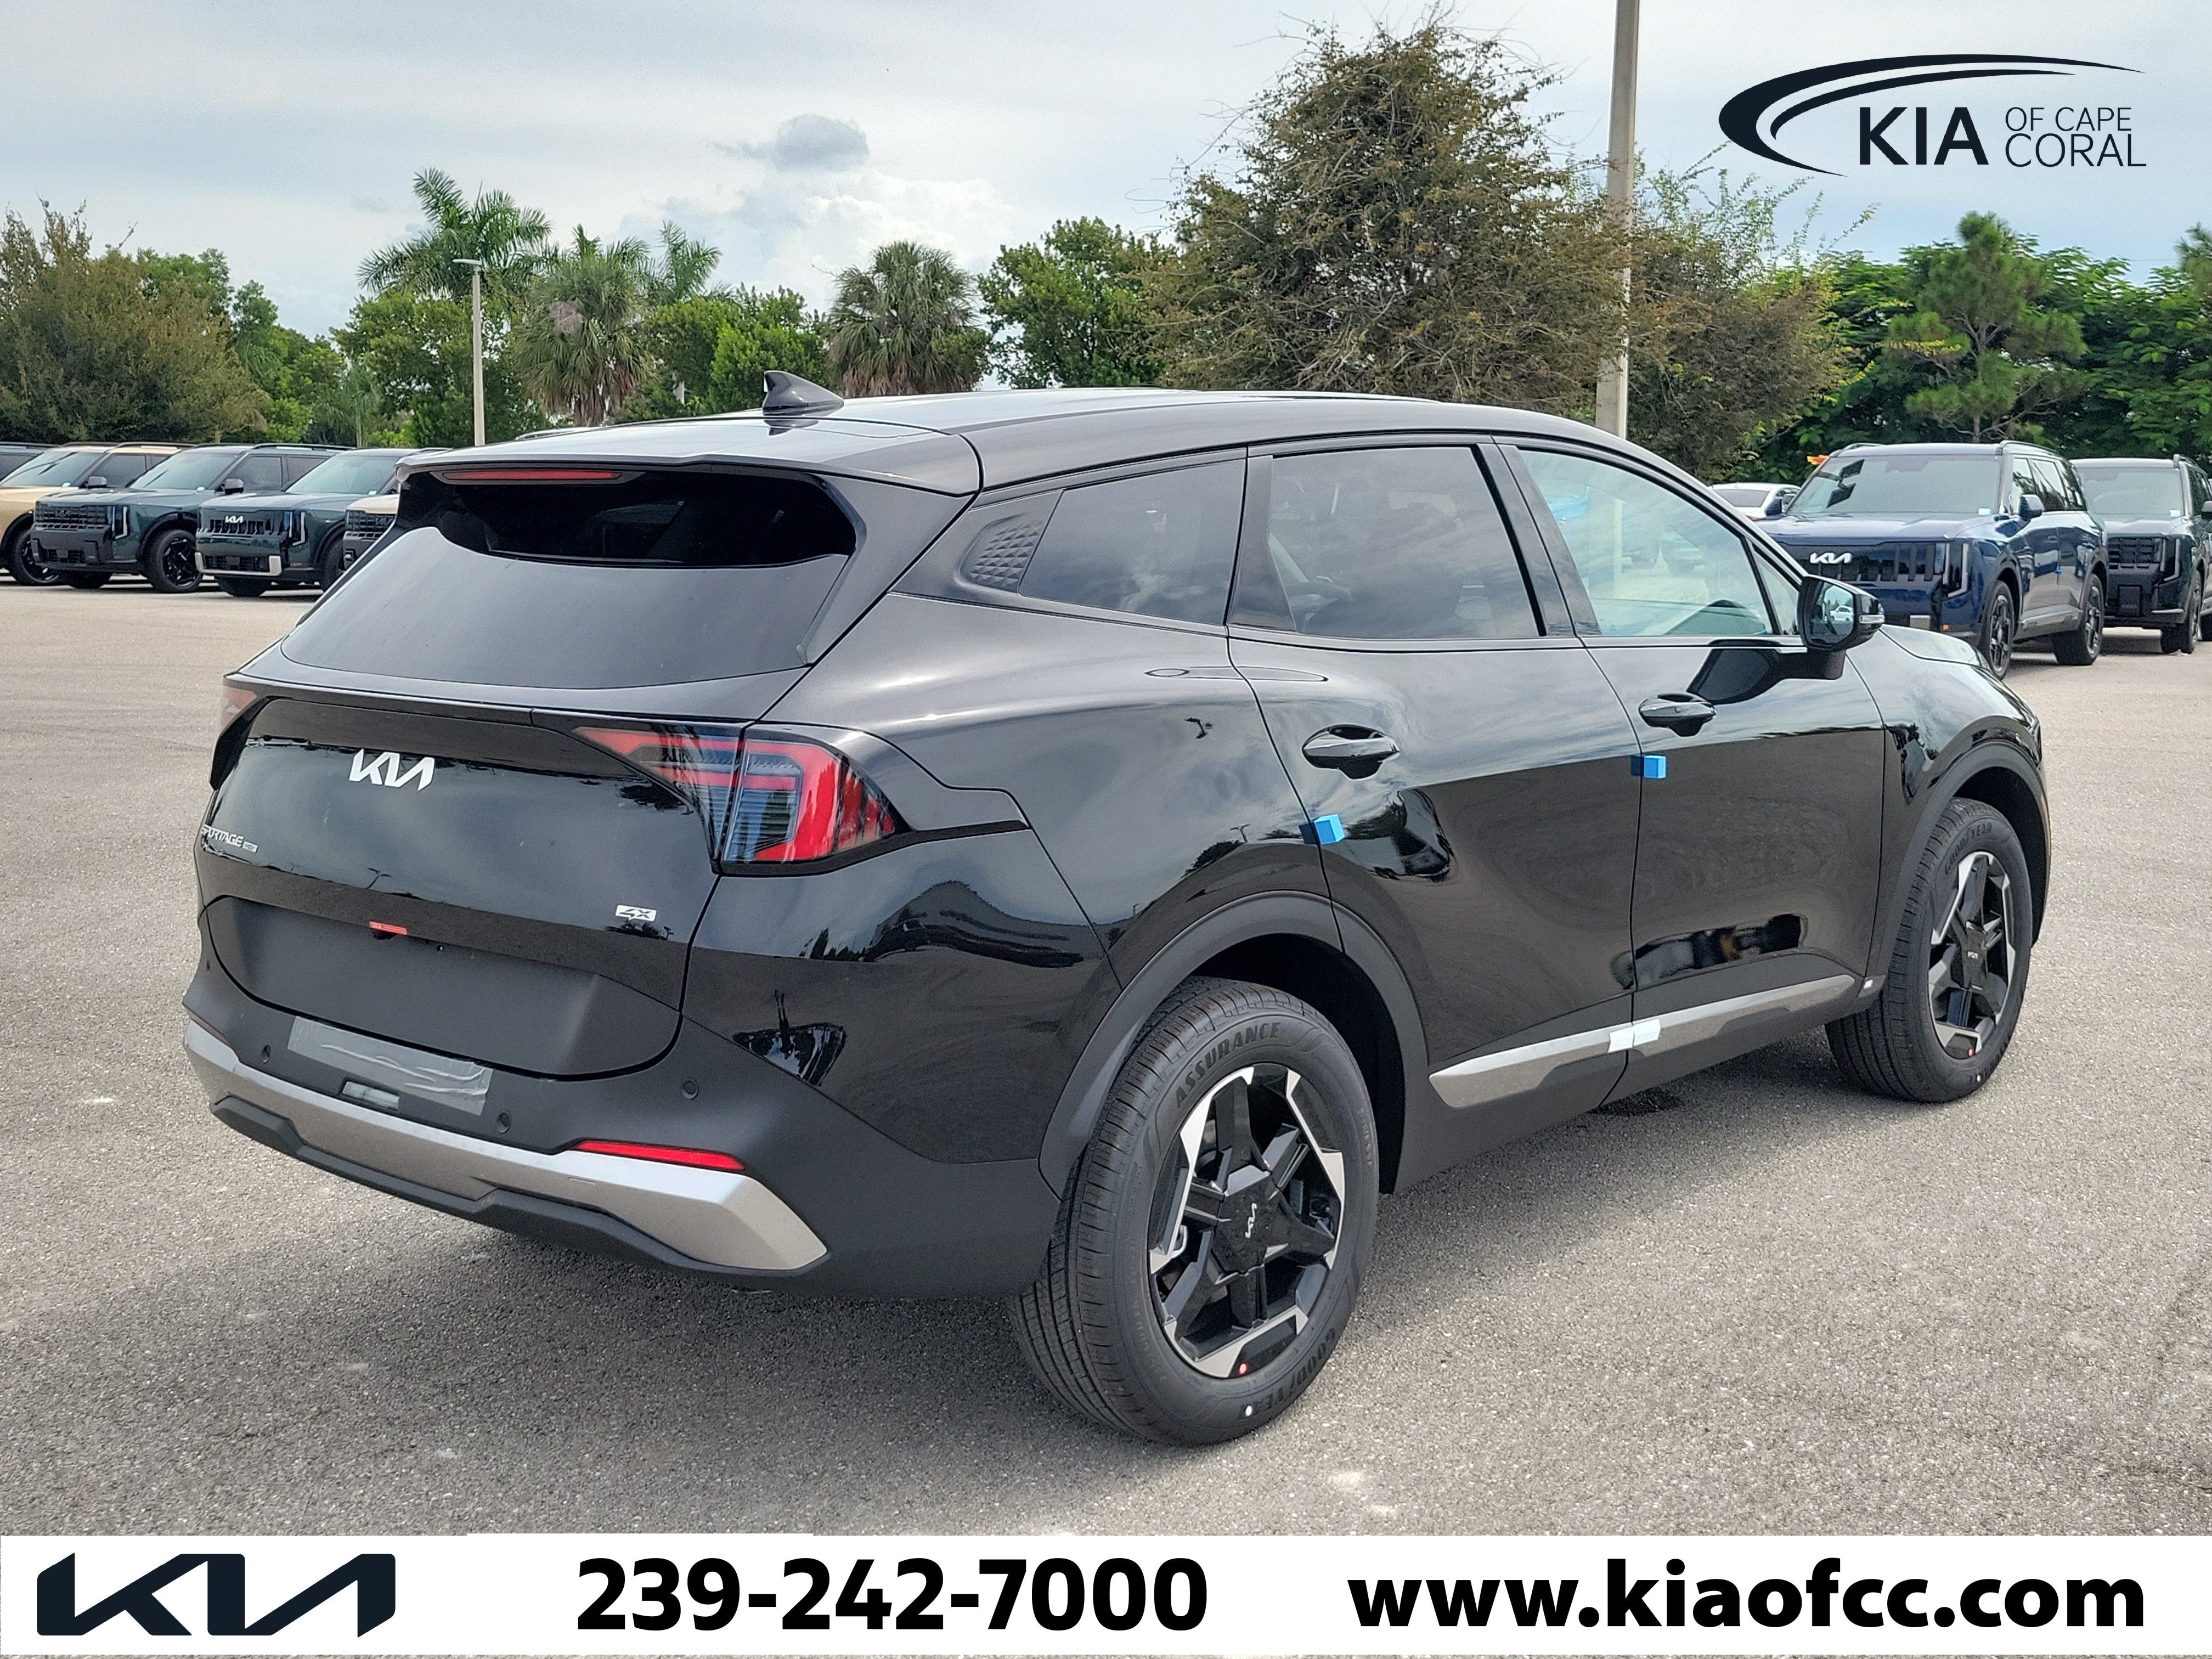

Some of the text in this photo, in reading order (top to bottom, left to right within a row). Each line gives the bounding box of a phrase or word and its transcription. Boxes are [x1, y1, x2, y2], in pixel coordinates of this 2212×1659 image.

[225, 515, 243, 523] KIA
[1810, 552, 1852, 564] KIA
[349, 748, 435, 791] KIA
[1175, 1022, 1282, 1108] ASSURANCE
